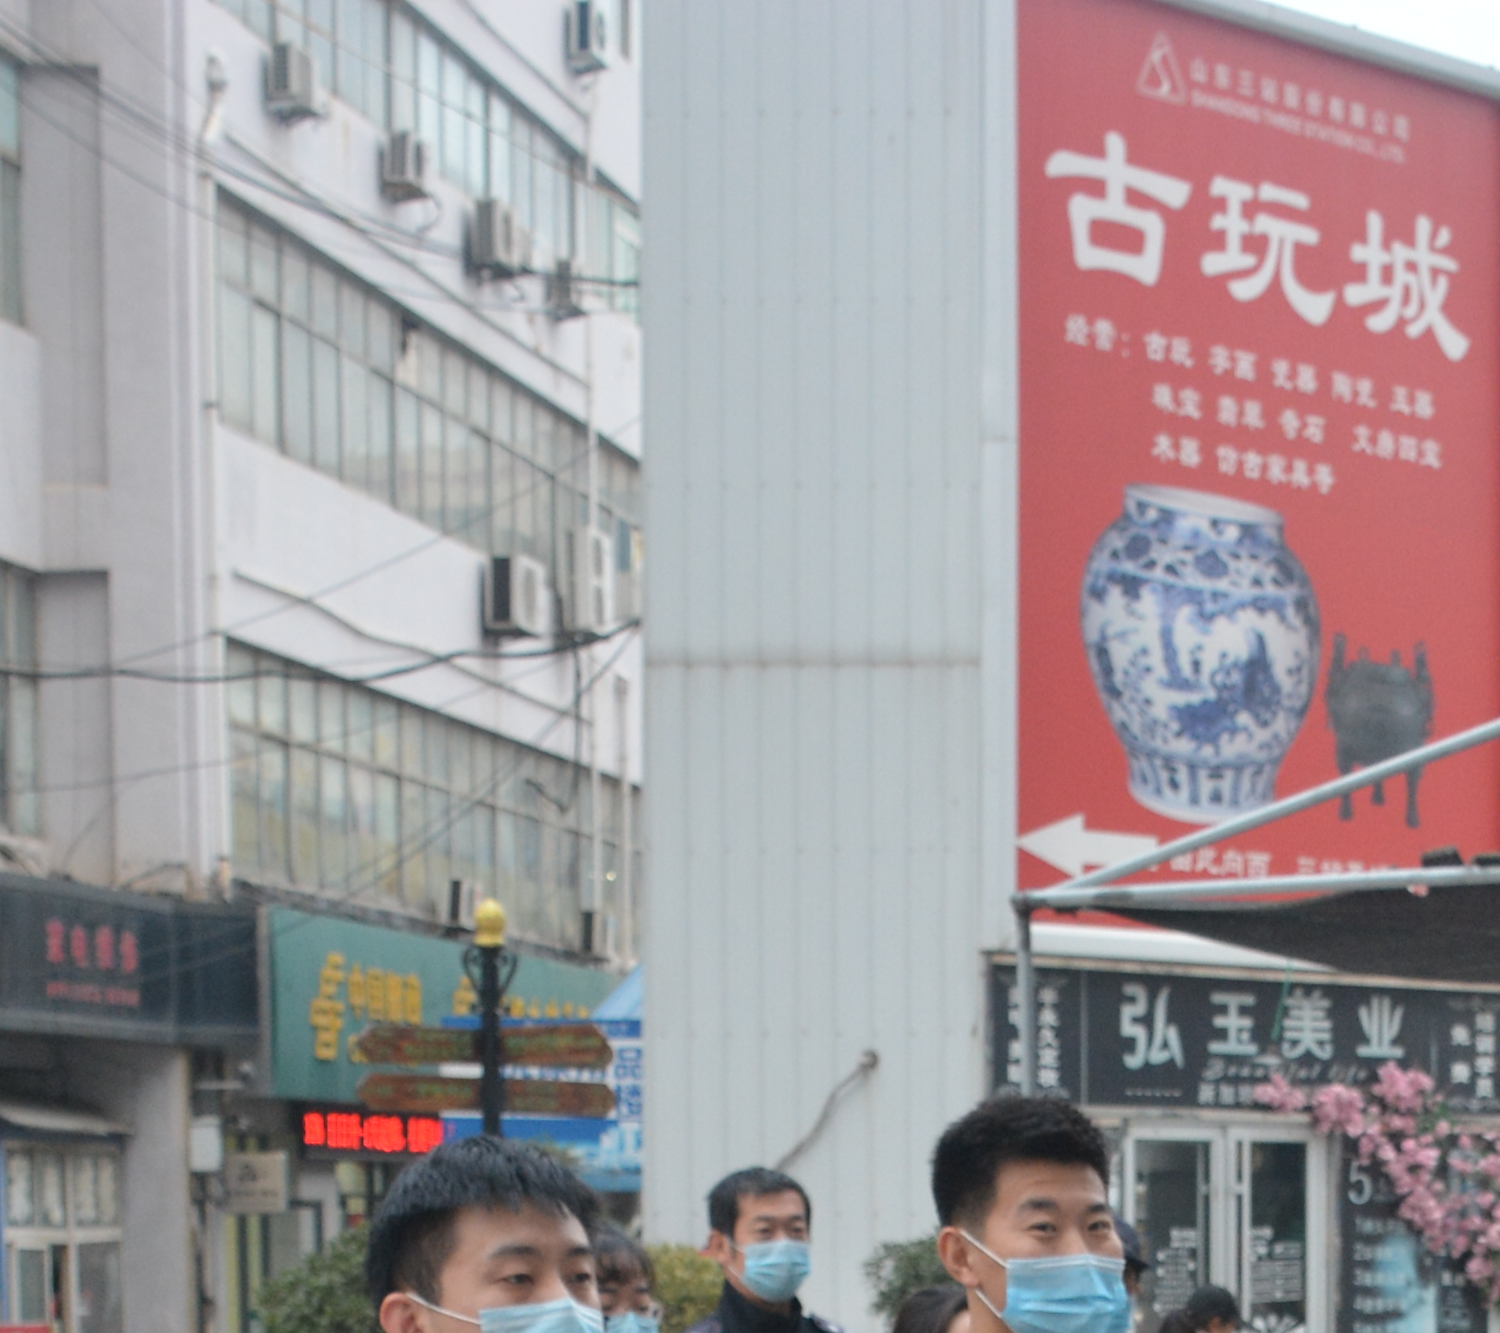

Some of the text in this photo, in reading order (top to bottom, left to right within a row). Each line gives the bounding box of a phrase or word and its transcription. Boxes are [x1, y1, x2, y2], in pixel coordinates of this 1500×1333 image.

[1044, 129, 1472, 364] 古玩城
[1118, 980, 1406, 1071] 弘玉美业
